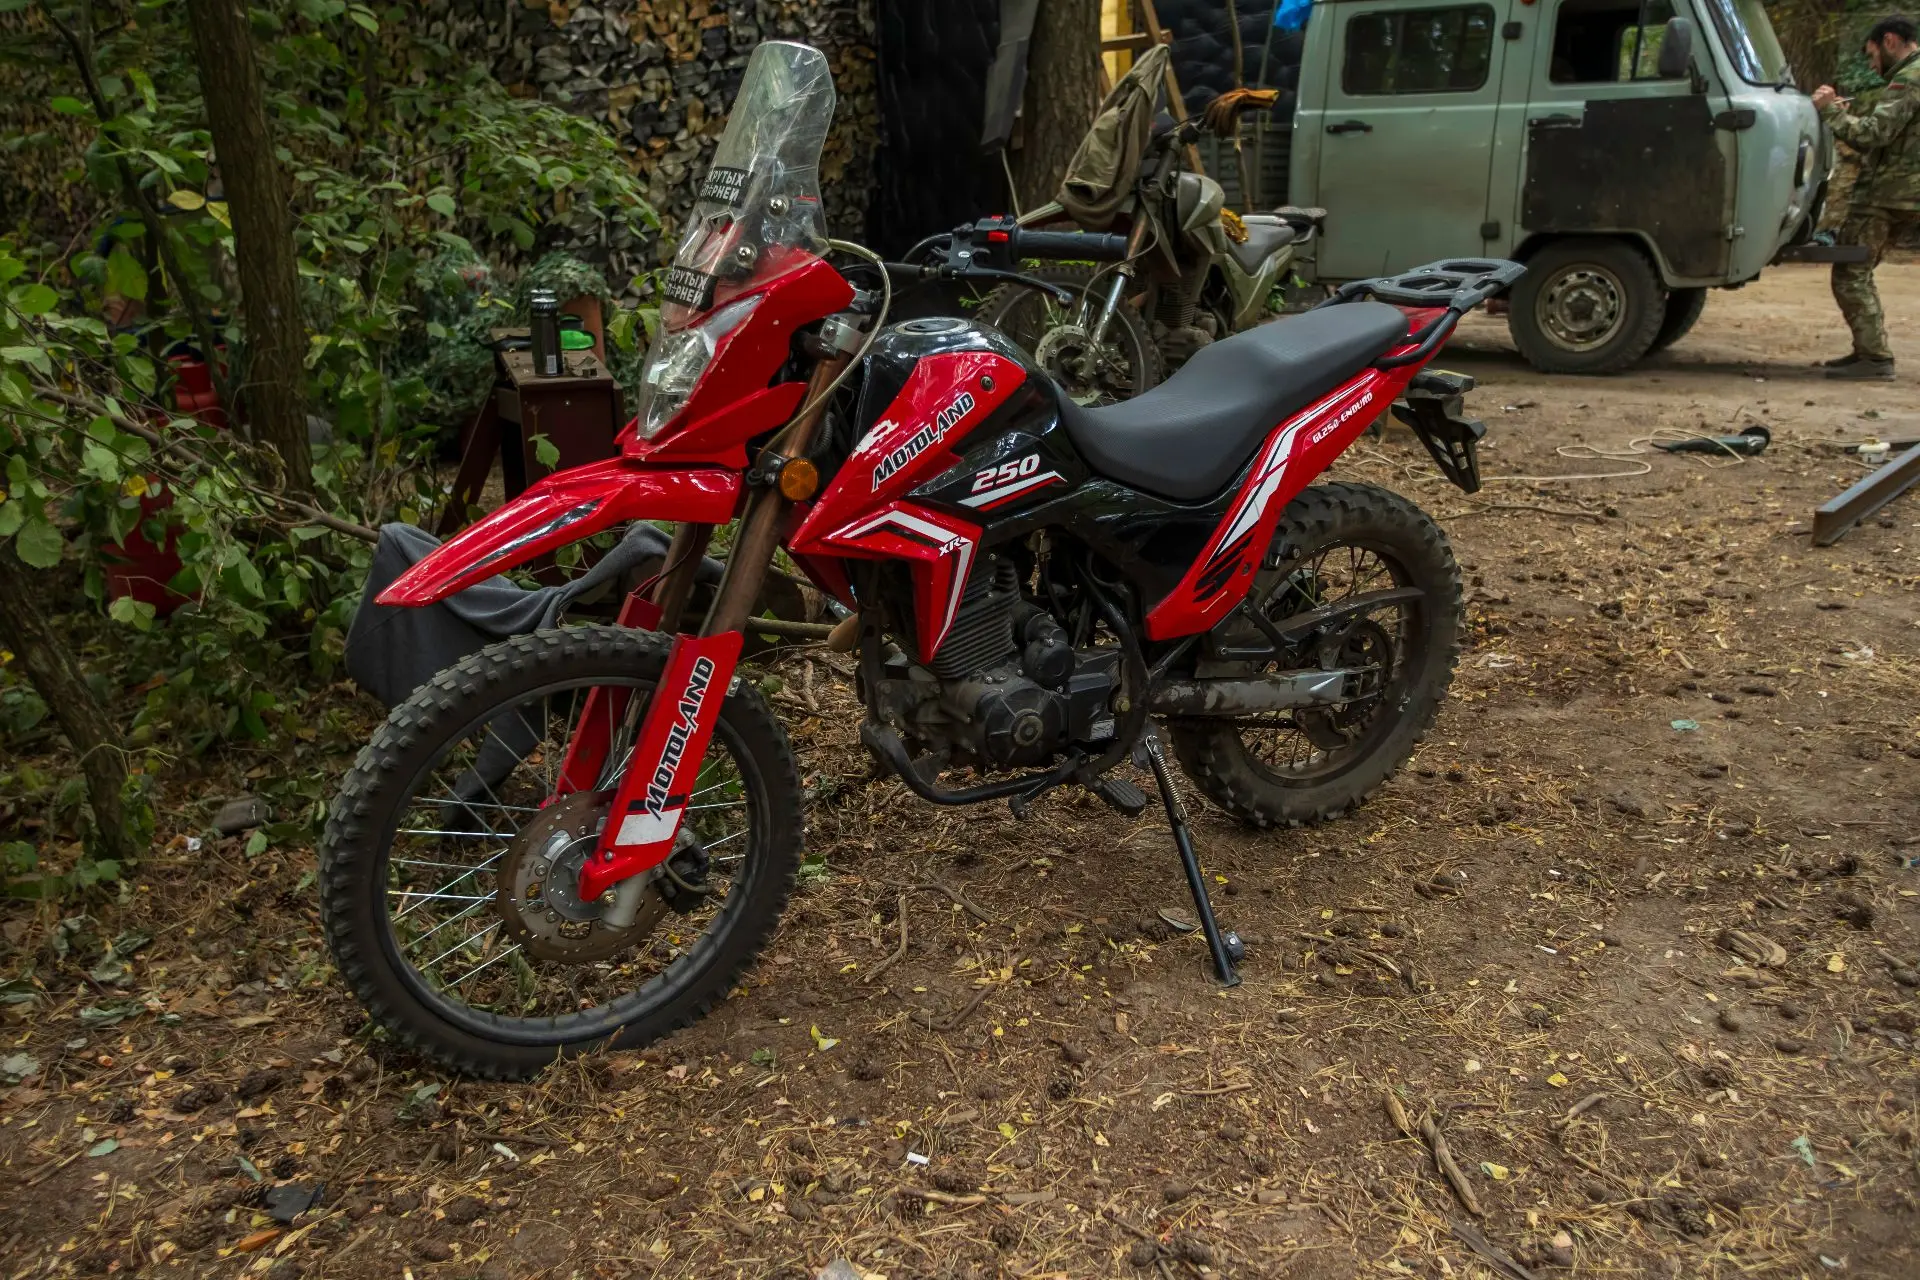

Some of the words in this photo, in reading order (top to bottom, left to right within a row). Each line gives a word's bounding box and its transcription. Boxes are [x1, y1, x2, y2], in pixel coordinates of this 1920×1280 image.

[871, 391, 975, 493] MOTOLAND
[971, 454, 1041, 494] 250
[645, 656, 715, 822] MOTOLAND
